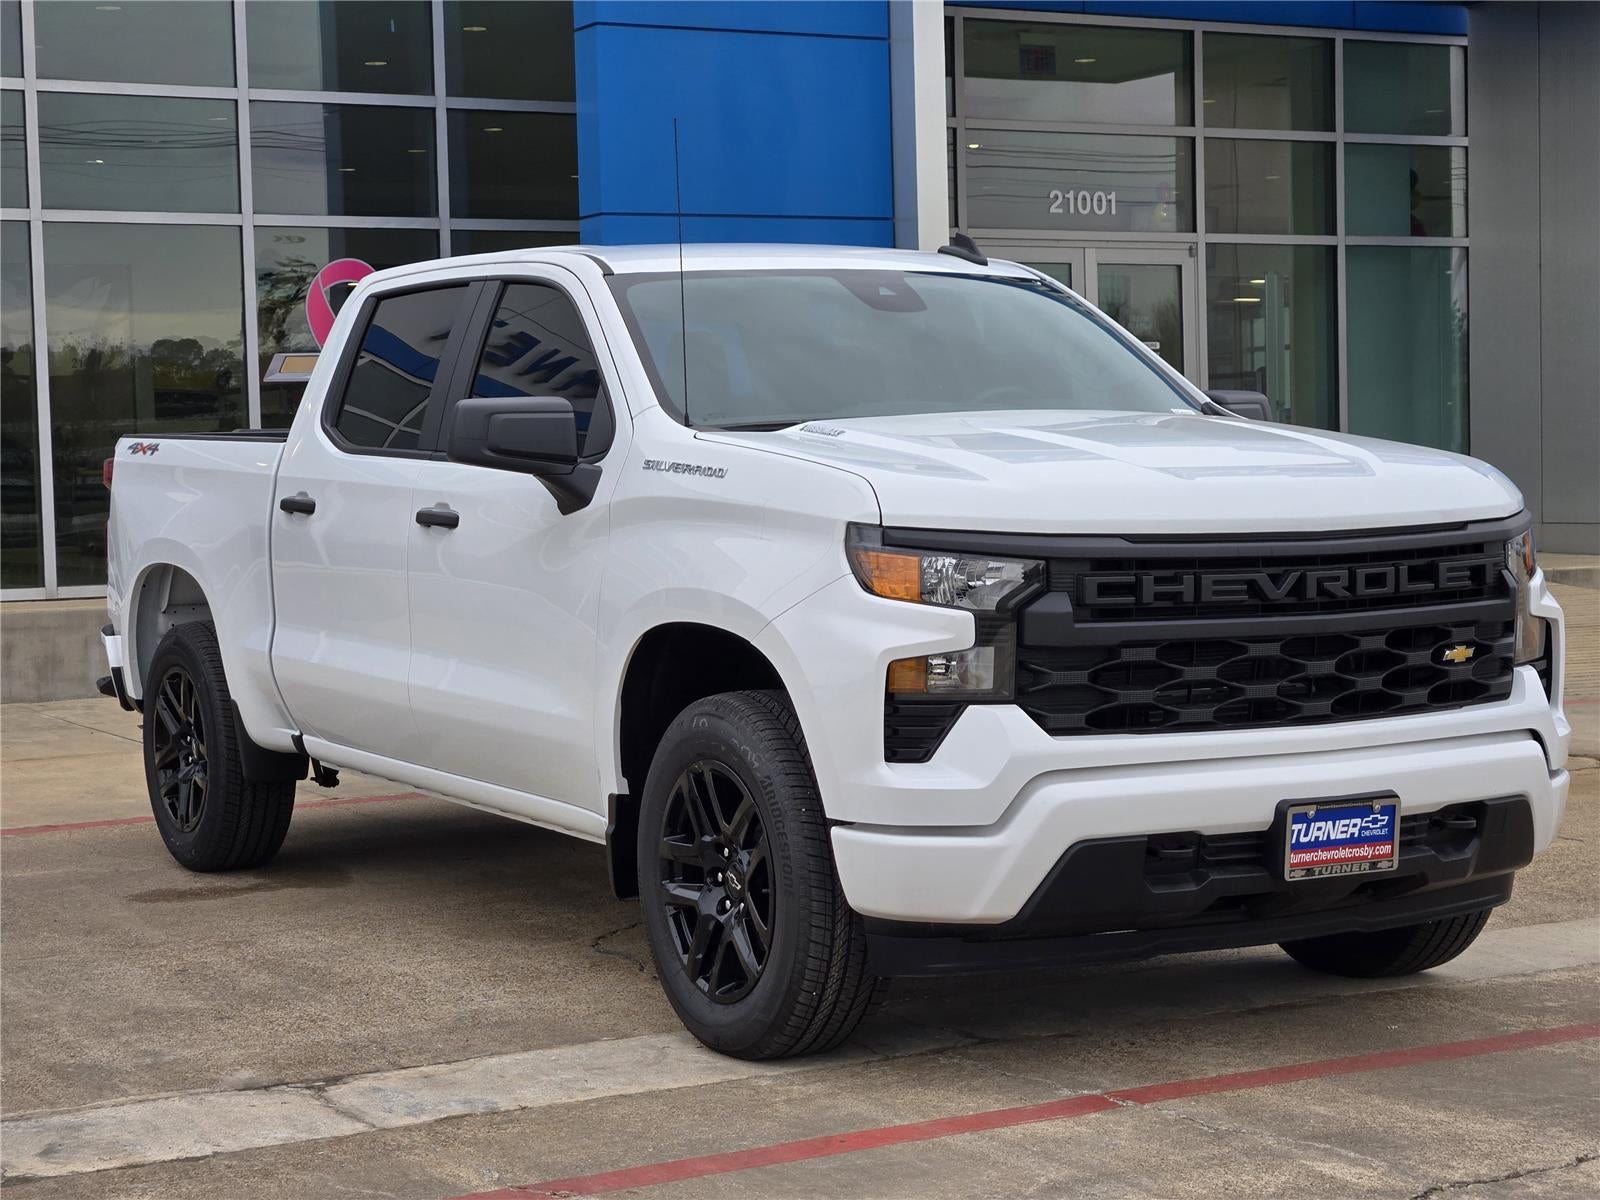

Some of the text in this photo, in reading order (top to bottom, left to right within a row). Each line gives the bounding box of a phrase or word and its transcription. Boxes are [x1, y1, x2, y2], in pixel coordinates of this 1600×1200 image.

[1049, 190, 1116, 215] 21001
[642, 459, 728, 478] SILVERADO
[1082, 557, 1504, 605] CHEVROLET
[1291, 818, 1362, 844] TURNER
[1361, 828, 1388, 837] CHEVROLET
[1290, 844, 1392, 863] turnerchevroletcrosby.com
[1313, 863, 1370, 875] TURNER
